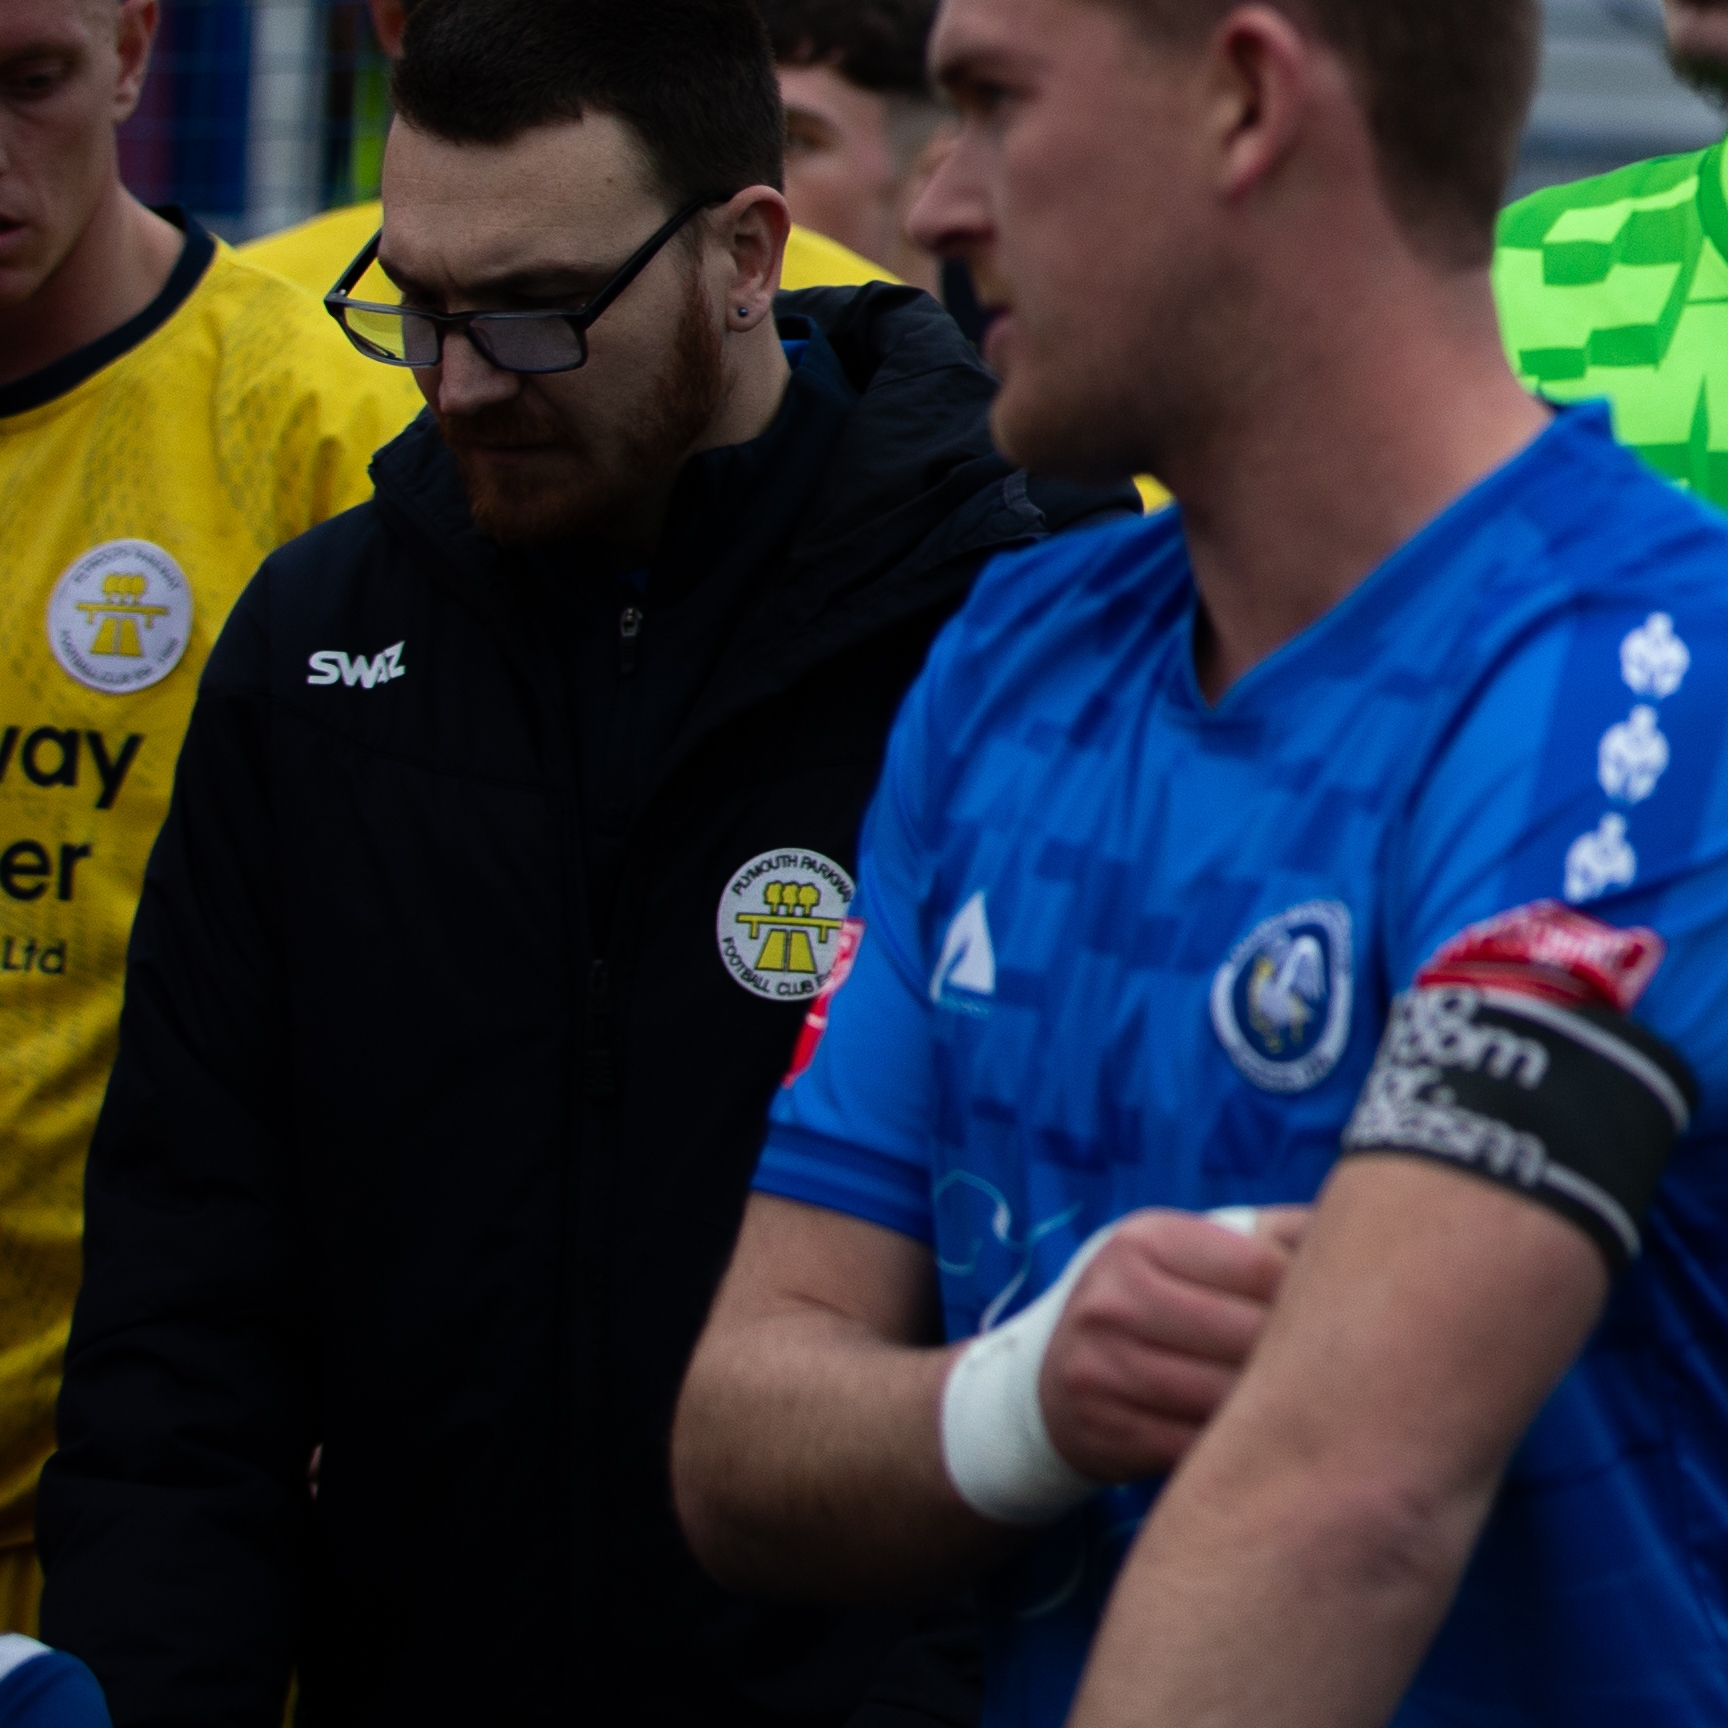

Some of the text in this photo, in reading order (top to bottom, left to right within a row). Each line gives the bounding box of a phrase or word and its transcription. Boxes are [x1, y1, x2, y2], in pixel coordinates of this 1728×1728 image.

[306, 639, 406, 689] SWAZ
[0, 725, 146, 811] ay
[731, 854, 852, 904] PLYMOUTH PARKWA
[2, 934, 67, 975] Ltd
[722, 935, 815, 996] FOOTBALL CLUB
